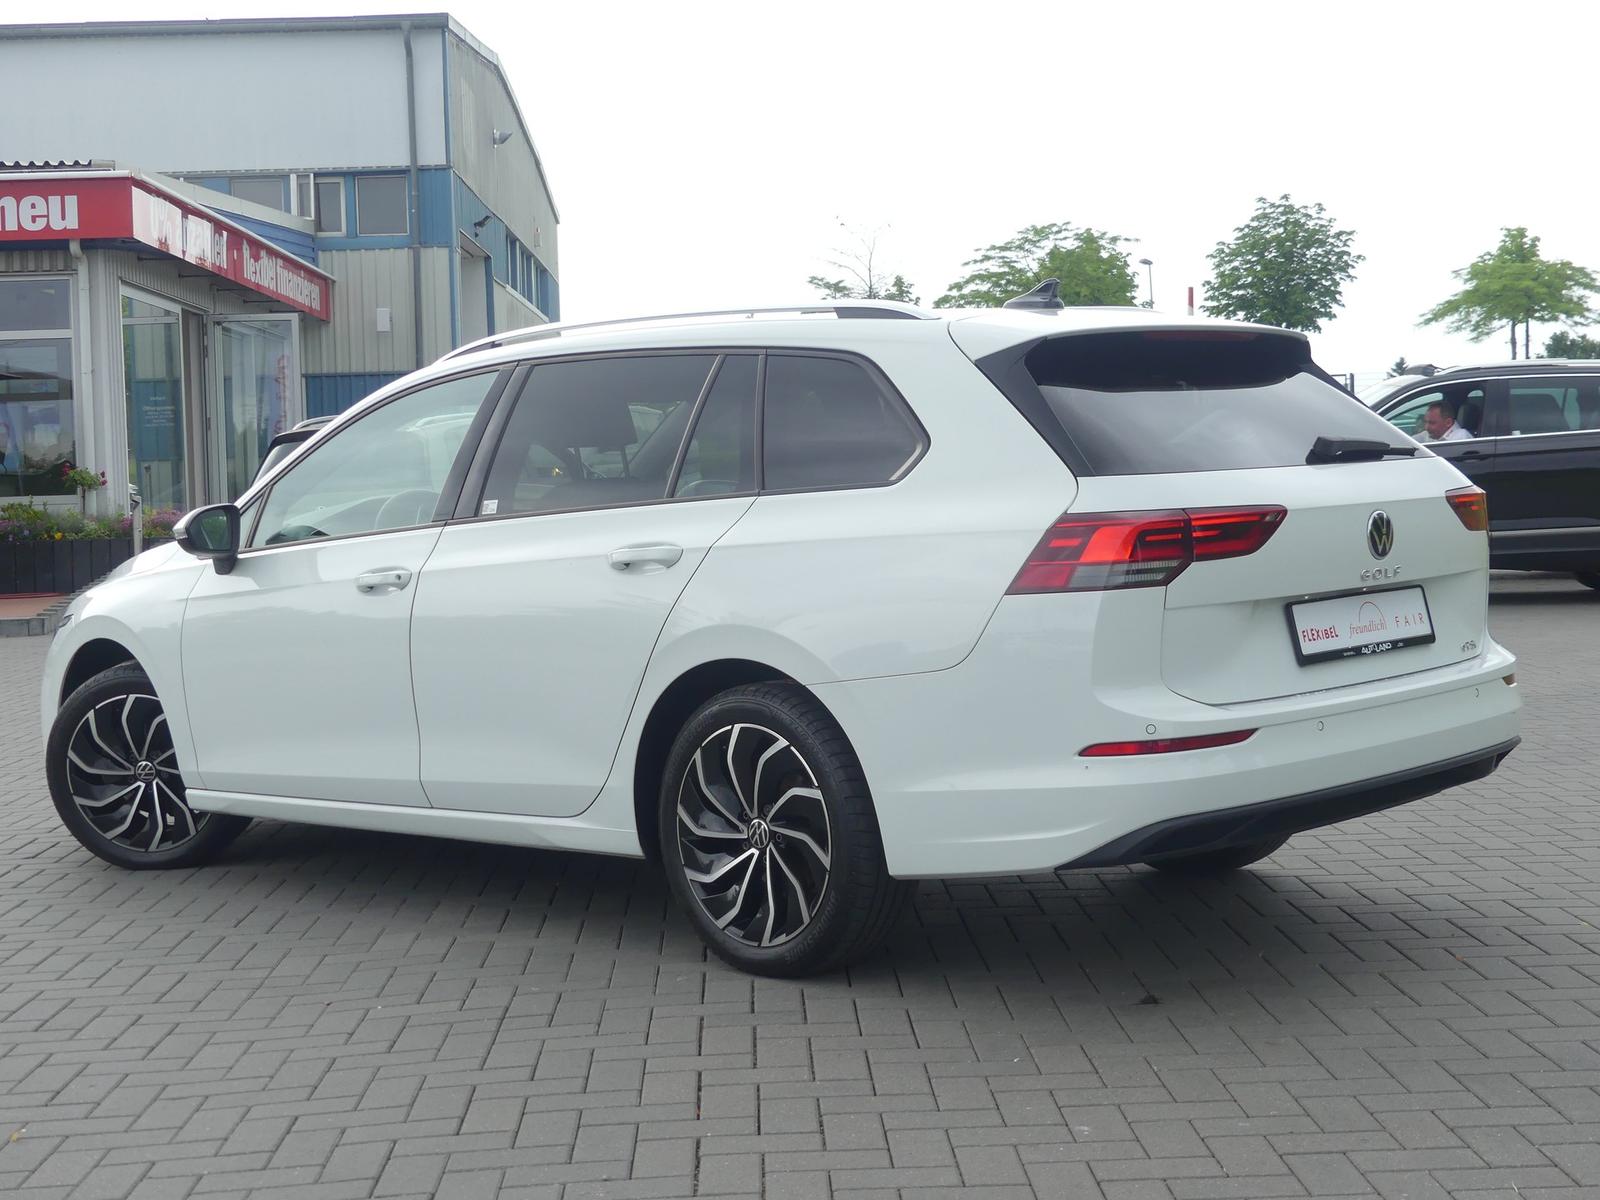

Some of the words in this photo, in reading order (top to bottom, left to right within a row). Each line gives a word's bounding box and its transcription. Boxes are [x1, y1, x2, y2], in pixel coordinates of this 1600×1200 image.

[243, 239, 276, 293] flexibel
[277, 258, 320, 312] finanzieren
[1360, 564, 1401, 580] GOLF
[1302, 625, 1339, 643] FLEXIBEL
